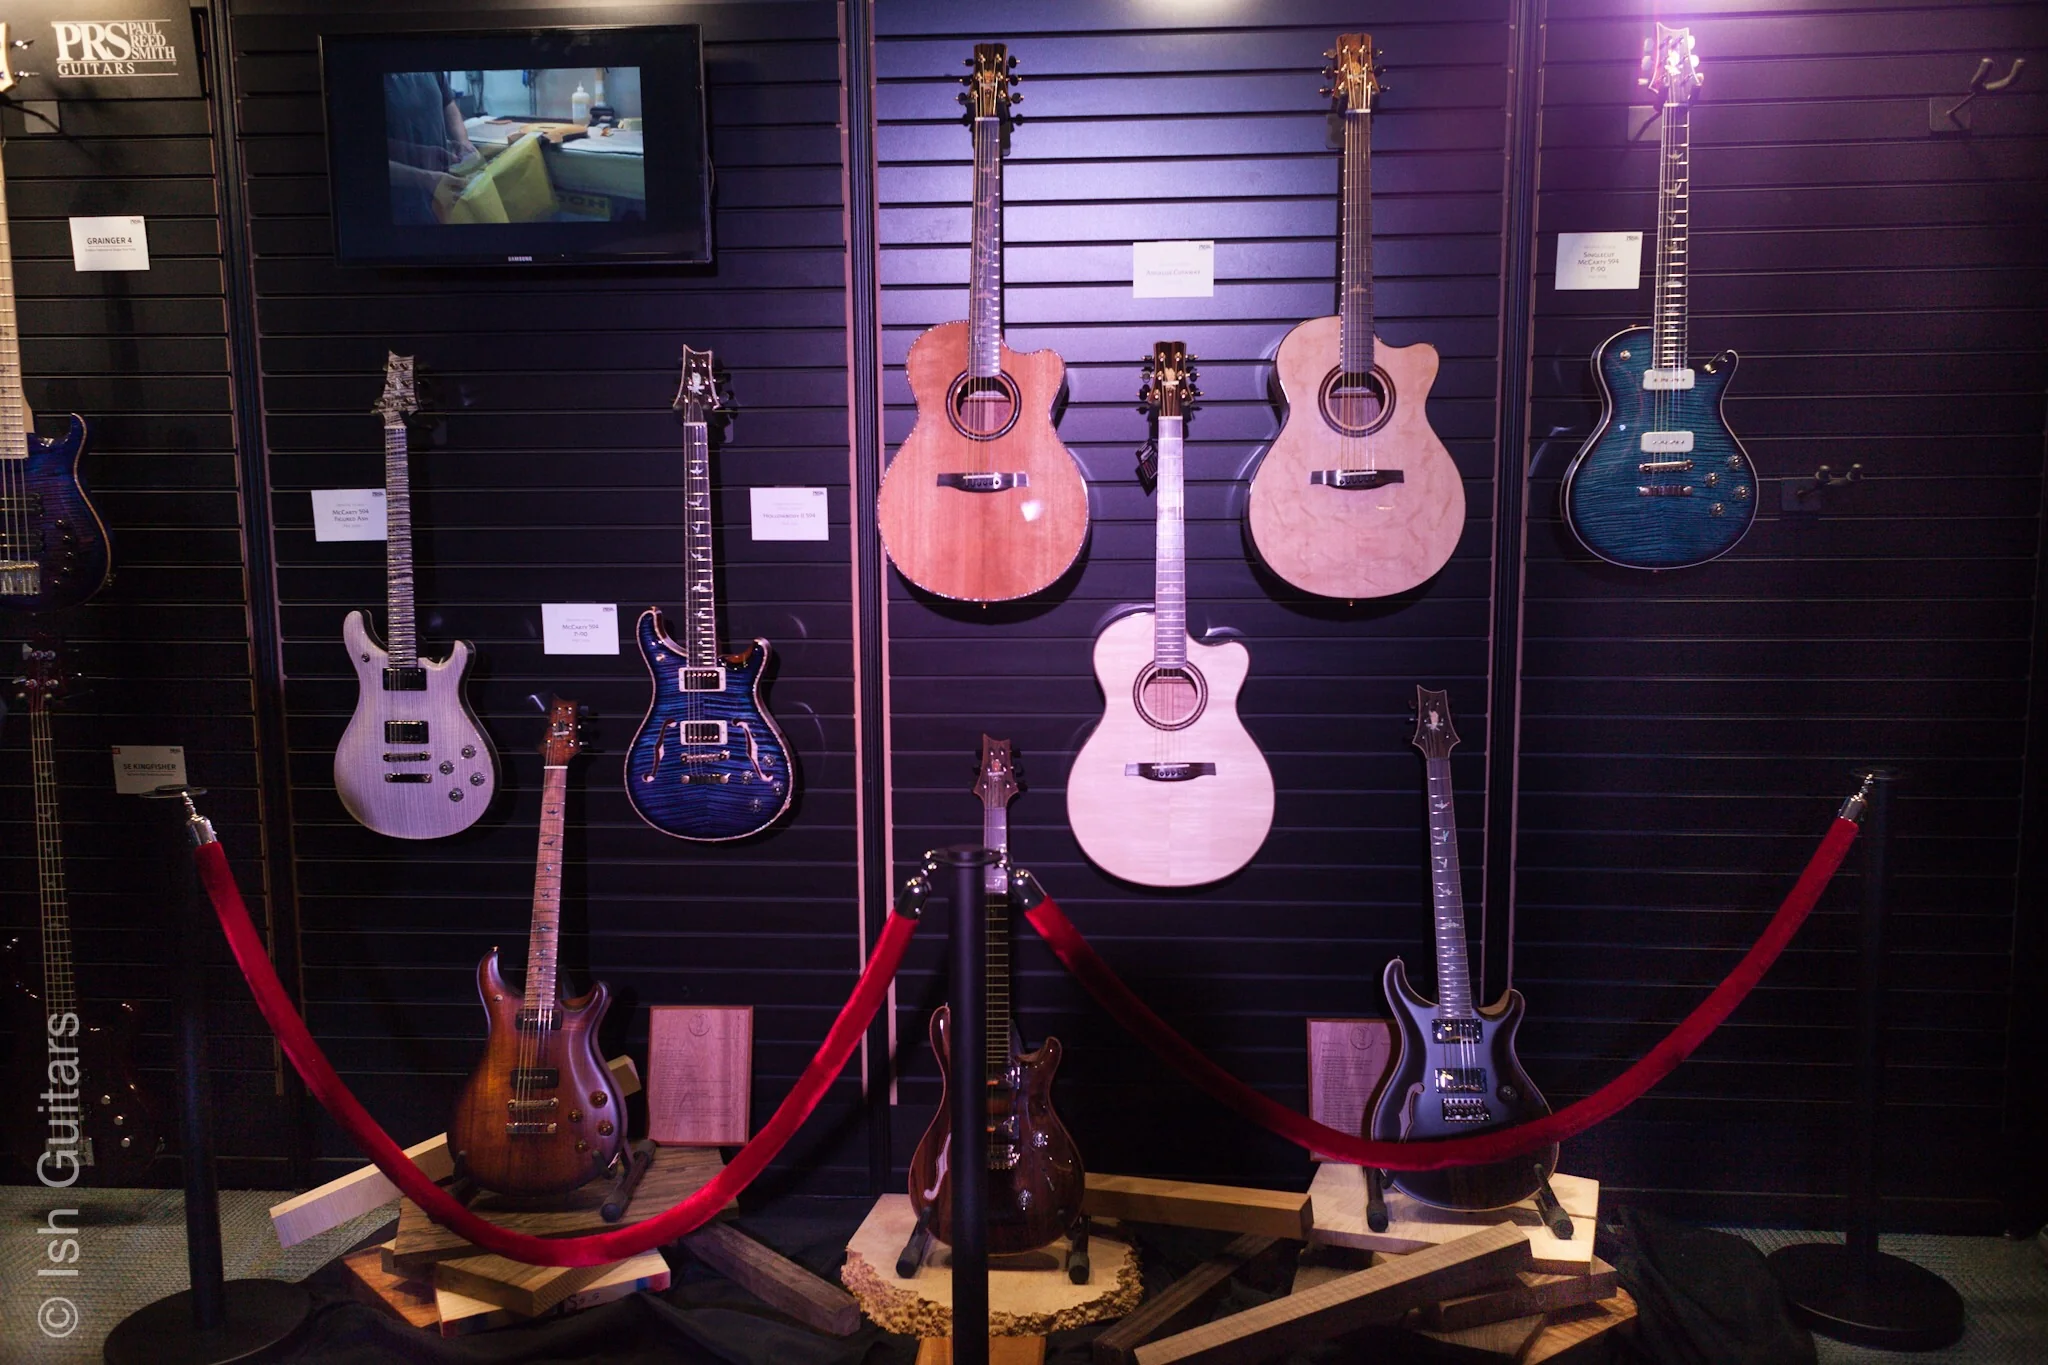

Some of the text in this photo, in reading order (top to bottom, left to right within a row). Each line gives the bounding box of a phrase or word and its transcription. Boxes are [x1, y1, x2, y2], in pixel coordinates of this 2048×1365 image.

[128, 22, 161, 35] PAUL
[51, 22, 132, 61] PRS
[129, 34, 166, 47] REED
[131, 46, 176, 60] SMITH
[57, 62, 135, 75] GUITARS
[86, 237, 126, 245] GRAINGER
